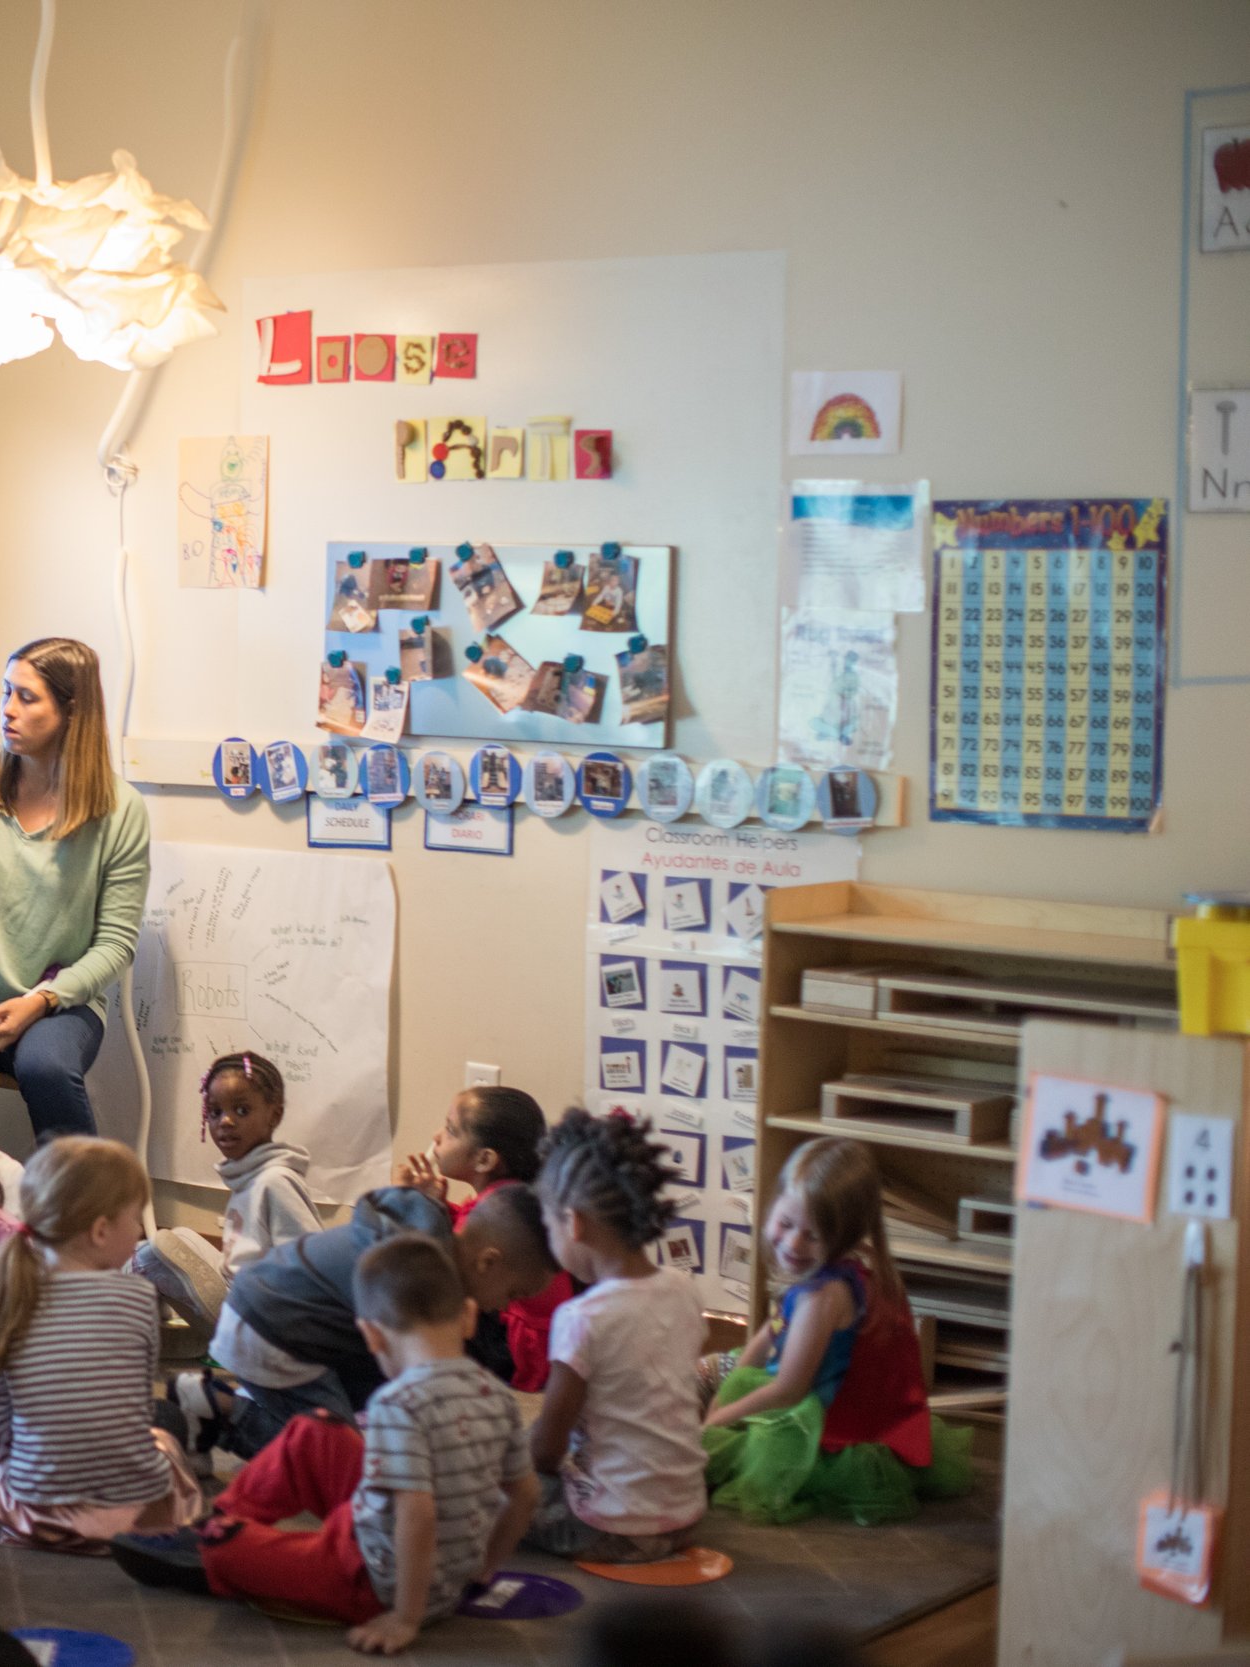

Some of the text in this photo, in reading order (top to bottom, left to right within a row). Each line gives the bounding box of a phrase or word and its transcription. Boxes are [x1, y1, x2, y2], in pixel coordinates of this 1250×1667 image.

[1213, 205, 1250, 238] A
[958, 505, 1137, 541] Numbers 1-100
[991, 557, 999, 570] 3
[1033, 558, 1041, 570] 5
[1053, 558, 1064, 569] 6
[1076, 556, 1084, 569] 7
[1117, 557, 1128, 570] 9
[1138, 557, 1153, 570] 10
[966, 582, 979, 595] 12
[987, 582, 1001, 596] 13
[1030, 582, 1044, 596] 15
[1116, 583, 1130, 596] 19
[1137, 583, 1155, 597] 20
[945, 607, 958, 621] 21
[964, 608, 980, 623] 22
[986, 608, 1003, 622] 23
[1007, 608, 1023, 622] 24
[1029, 609, 1045, 622] 25
[1071, 609, 1088, 623] 27
[1115, 609, 1132, 623] 29
[1136, 610, 1155, 624] 30
[945, 633, 958, 647] 31
[964, 633, 980, 647] 32
[986, 634, 1003, 648] 33
[1007, 634, 1023, 648] 34
[1029, 635, 1045, 649] 35
[1050, 635, 1067, 649] 36
[1072, 635, 1089, 649] 37
[1116, 636, 1133, 650] 39
[962, 660, 979, 673] 42
[984, 660, 1002, 674] 43
[1006, 661, 1022, 673] 44
[1026, 661, 1044, 675] 45
[1048, 662, 1066, 675] 46
[1069, 662, 1088, 675] 47
[1113, 663, 1132, 676] 49
[943, 685, 955, 698] 51
[962, 685, 978, 699] 52
[984, 686, 1001, 700] 53
[1005, 687, 1021, 700] 54
[1026, 687, 1043, 701] 55
[1047, 688, 1065, 702] 56
[1069, 688, 1087, 702] 57
[1113, 690, 1131, 703] 59
[942, 712, 956, 724] 61
[962, 711, 978, 725] 62
[983, 712, 1001, 726] 63
[1005, 714, 1021, 726] 64
[1025, 714, 1043, 727] 65
[1048, 715, 1064, 728] 66
[1069, 715, 1087, 728] 67
[1112, 716, 1131, 730] 69
[1136, 717, 1152, 731] 70
[942, 736, 955, 749] 71
[962, 737, 977, 751] 72
[984, 738, 1000, 752] 73
[1004, 739, 1020, 751] 74
[1026, 740, 1042, 754] 75
[1048, 740, 1063, 754] 76
[1068, 741, 1085, 754] 77
[1112, 743, 1130, 756] 79
[1133, 743, 1151, 758] 80
[941, 762, 954, 776] 81
[961, 763, 977, 777] 82
[982, 764, 999, 778] 83
[1004, 765, 1020, 779] 84
[1024, 766, 1042, 780] 85
[1067, 768, 1085, 781] 87
[1110, 769, 1128, 783] 89
[1131, 770, 1151, 784] 90
[334, 801, 359, 811] DAILY
[961, 790, 977, 802] 92
[983, 790, 999, 803] 93
[1002, 791, 1019, 804] 94
[1023, 792, 1040, 805] 95
[1044, 793, 1061, 806] 96
[1066, 794, 1083, 806] 97
[1111, 796, 1129, 808] 99
[1132, 797, 1154, 811] 100
[325, 817, 371, 828] SCHEDULE
[451, 828, 483, 839] DIARIO
[645, 827, 729, 847] Classroom
[641, 852, 801, 877] Ayudantes de Aula
[182, 969, 239, 1011] Robots
[1195, 1129, 1211, 1148] 4
